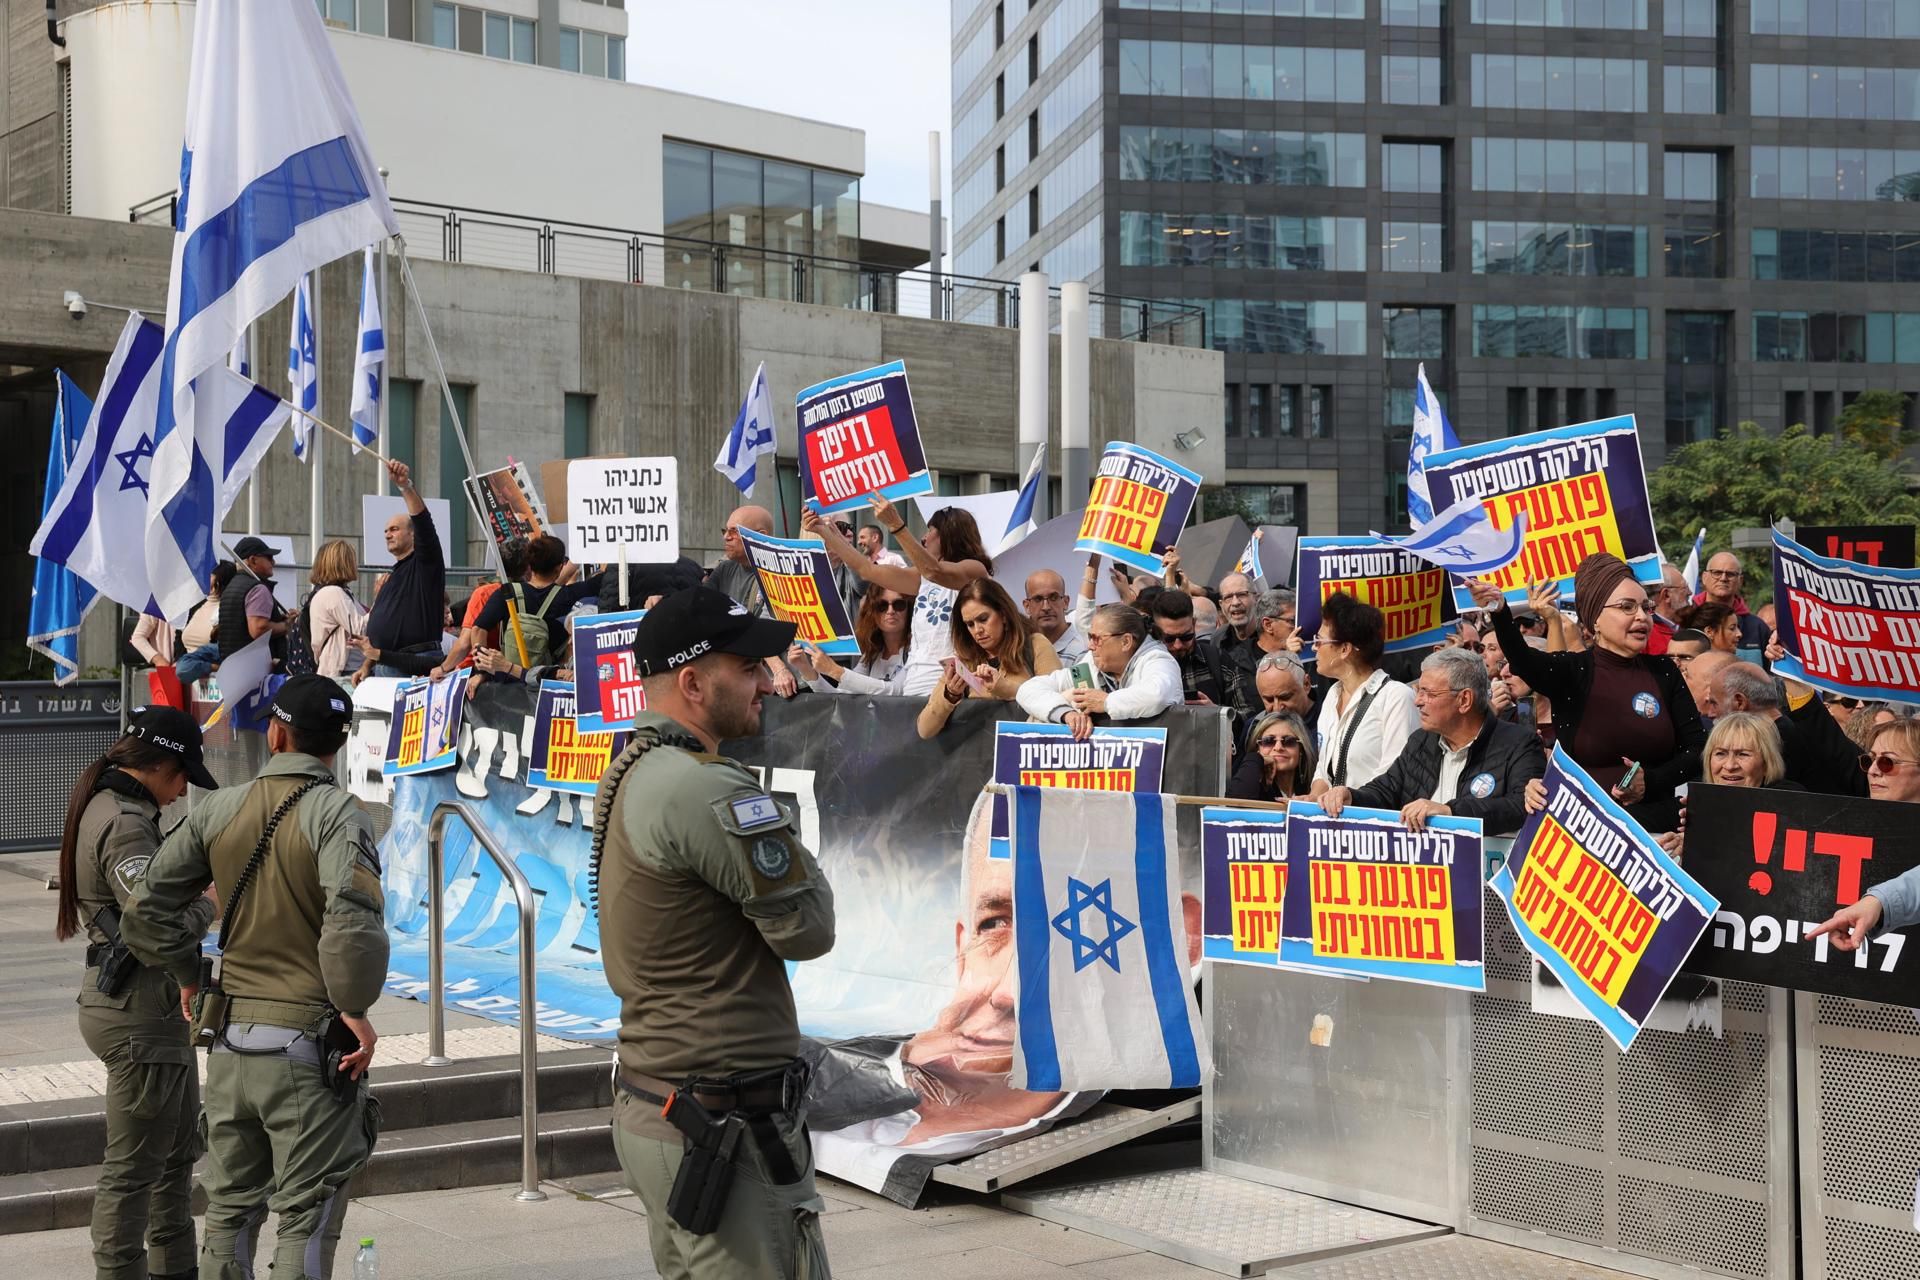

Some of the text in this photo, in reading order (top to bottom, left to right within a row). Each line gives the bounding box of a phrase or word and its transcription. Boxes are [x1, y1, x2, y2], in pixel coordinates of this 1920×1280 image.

[803, 383, 886, 428] משפט בזמן המלחמה
[816, 414, 875, 464] רדיפה
[604, 468, 662, 487] נתניהו
[819, 450, 896, 502] ומזימה!
[1129, 459, 1181, 495] קליקה
[1449, 437, 1609, 502] קליקה משפטית
[582, 496, 667, 515] אנשי האור
[1094, 477, 1165, 519] פוגעת
[1506, 473, 1608, 532] פוגעת
[576, 524, 669, 548] תומכים בך
[778, 550, 816, 577] קליקה
[1319, 551, 1395, 579] משפטית
[1780, 556, 1872, 608] משפטית
[771, 574, 819, 607] פוגעת
[1366, 568, 1442, 610] פוגעת
[1788, 590, 1880, 643] ישראל
[667, 639, 712, 669] POLICE
[271, 702, 292, 723] משטרה
[152, 735, 185, 753] POLICE
[550, 719, 575, 748] בנו
[550, 751, 606, 781] בטחונית!
[1018, 740, 1144, 770] קליקה משפטית
[1226, 832, 1288, 861] שפטית
[1307, 827, 1388, 861] משפטית
[1393, 831, 1455, 866] קליקה
[1548, 782, 1685, 922] קליקה משפטית
[1748, 811, 1874, 906] די!
[1231, 864, 1268, 904] בנו
[1311, 862, 1351, 905] בנו
[1357, 864, 1448, 910] פוגעת
[1531, 817, 1655, 954] פוגעת בנו
[1317, 911, 1445, 961] בטחונית!
[1515, 866, 1622, 996] בטחונית!
